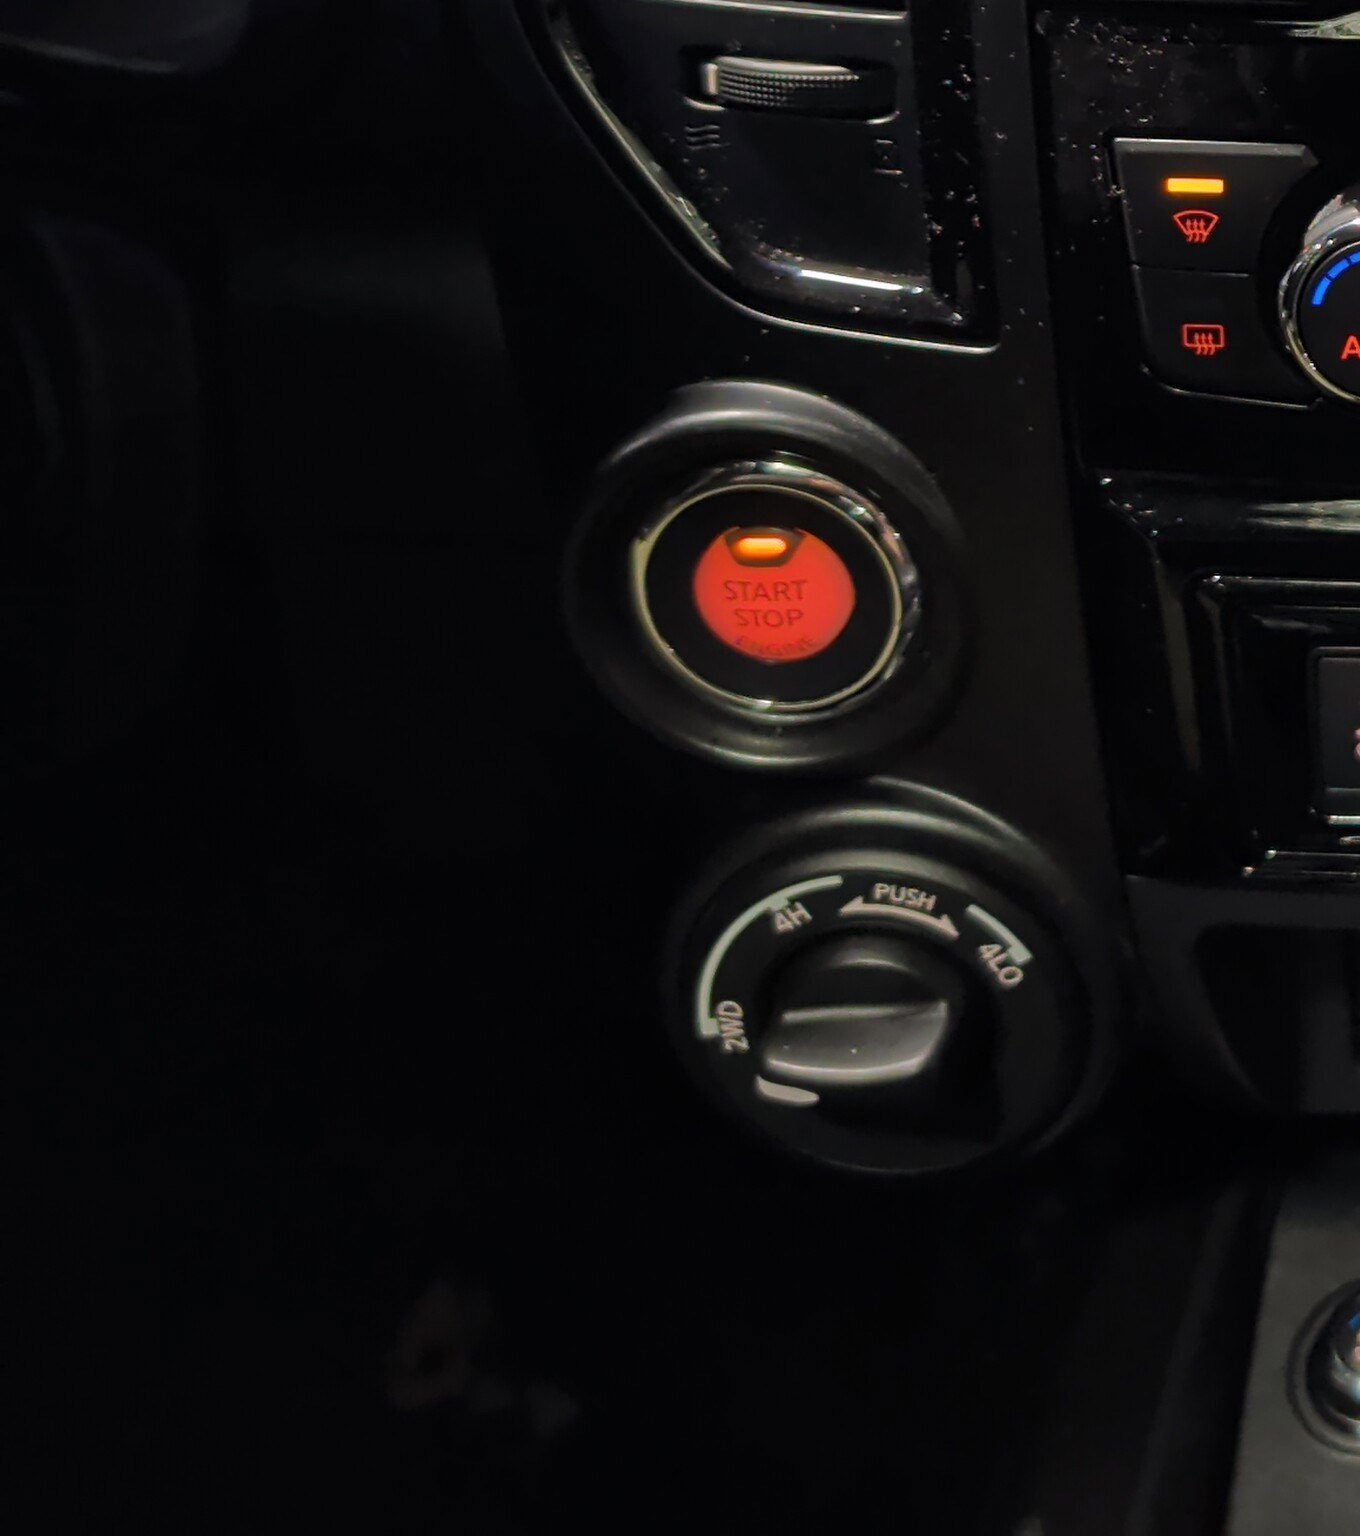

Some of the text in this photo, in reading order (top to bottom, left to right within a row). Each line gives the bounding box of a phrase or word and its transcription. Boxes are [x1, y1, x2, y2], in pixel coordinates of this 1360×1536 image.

[723, 578, 807, 601] START
[734, 607, 804, 628] STOP
[873, 882, 937, 912] PUSH
[773, 901, 813, 935] 4H
[978, 942, 1025, 990] 4LO
[714, 1000, 750, 1055] 2WD
